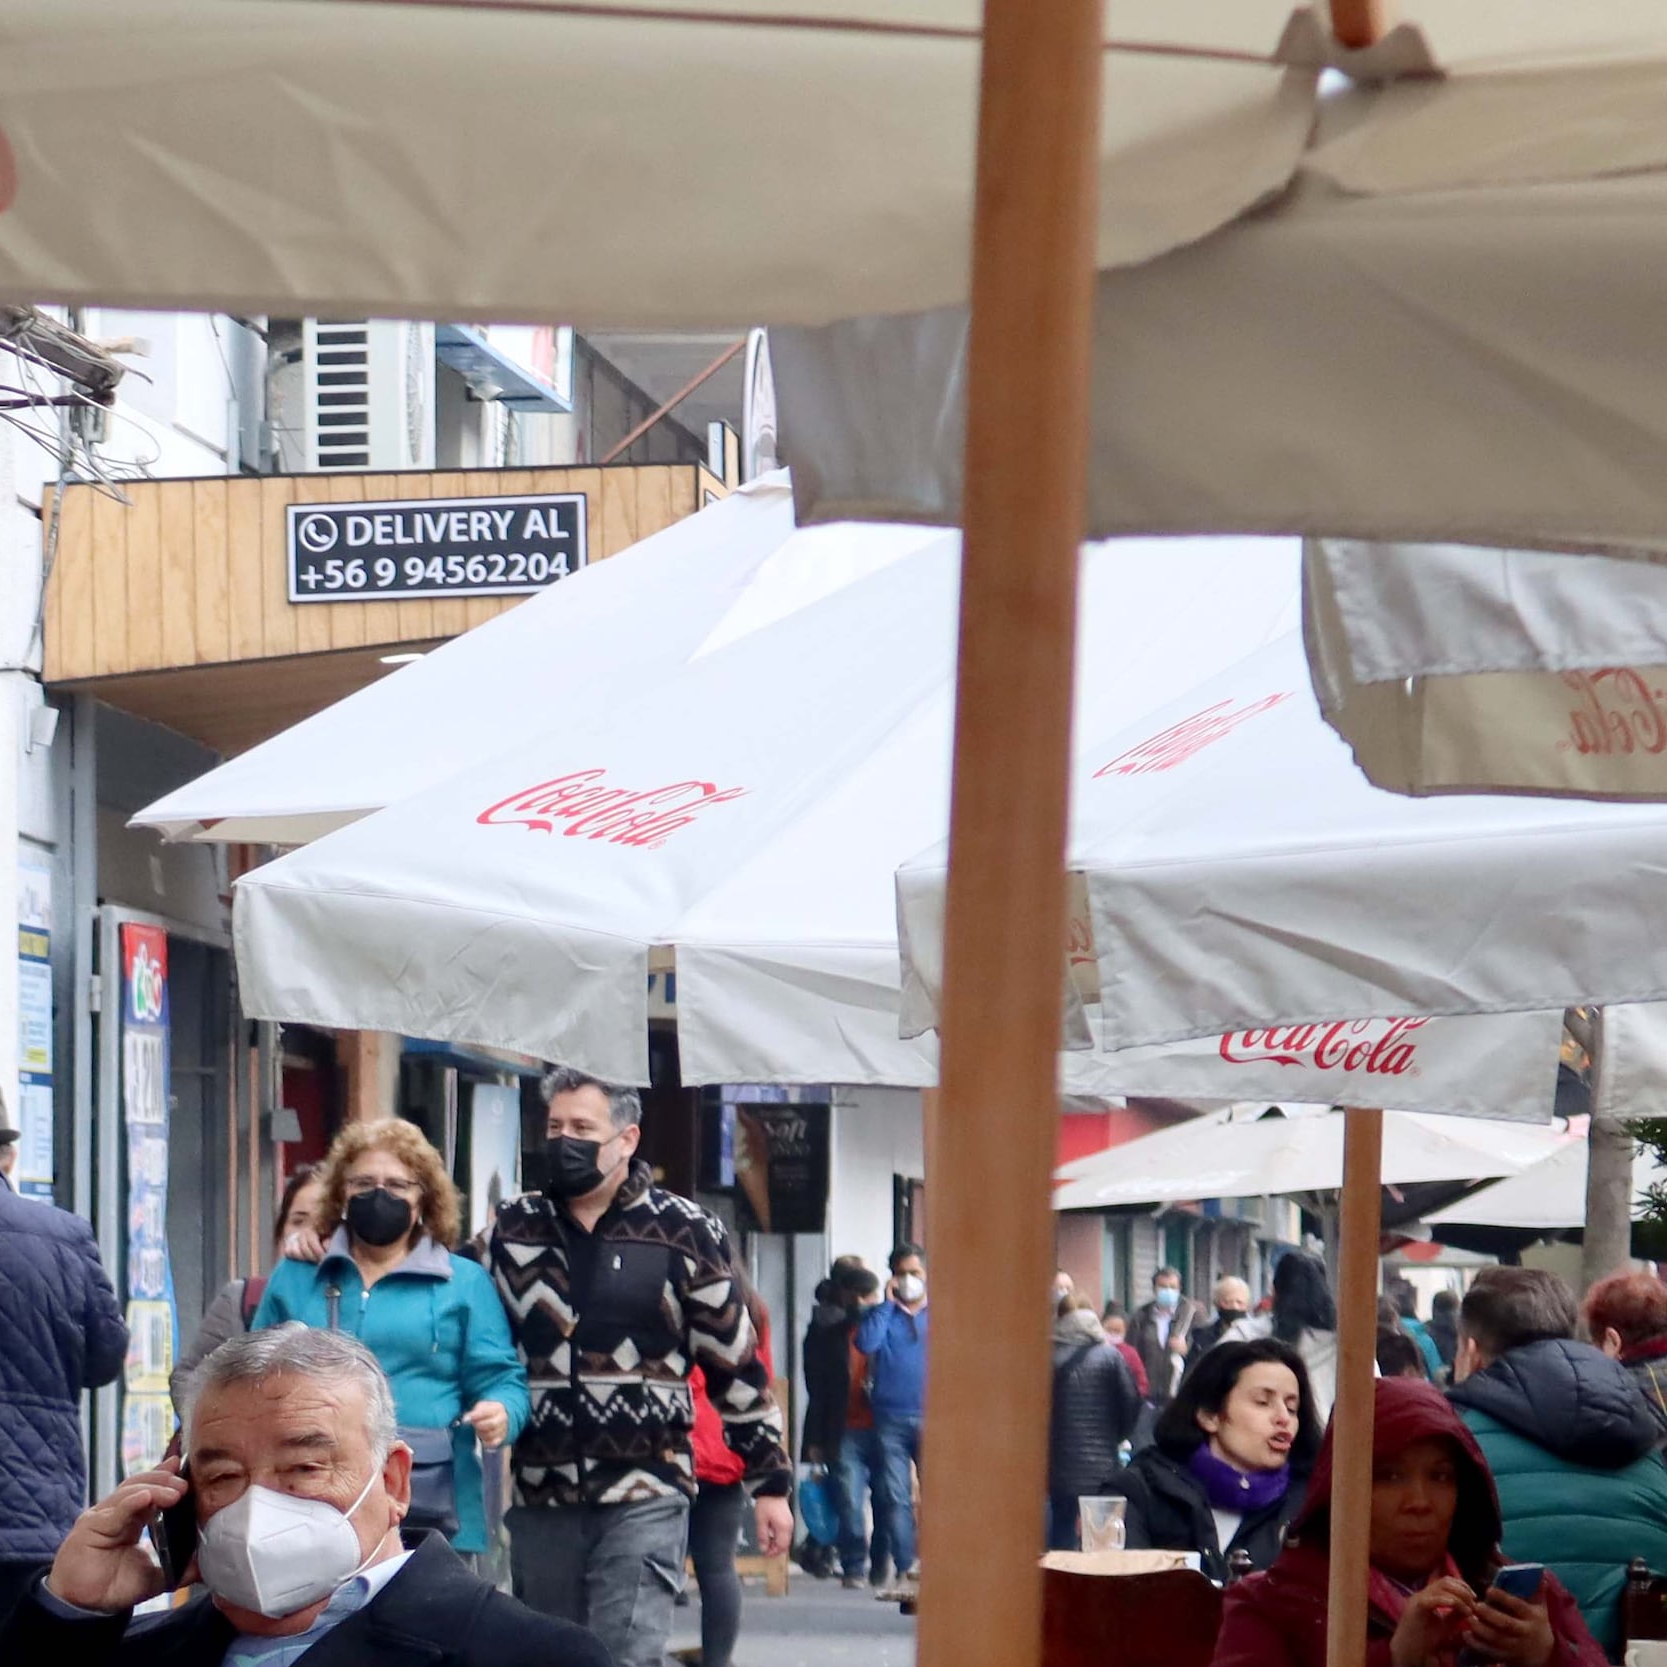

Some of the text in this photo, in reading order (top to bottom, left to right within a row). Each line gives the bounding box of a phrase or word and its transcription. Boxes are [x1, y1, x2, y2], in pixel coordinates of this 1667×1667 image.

[345, 507, 569, 547] DELIVERY AL
[299, 551, 570, 590] +56 9 94562204
